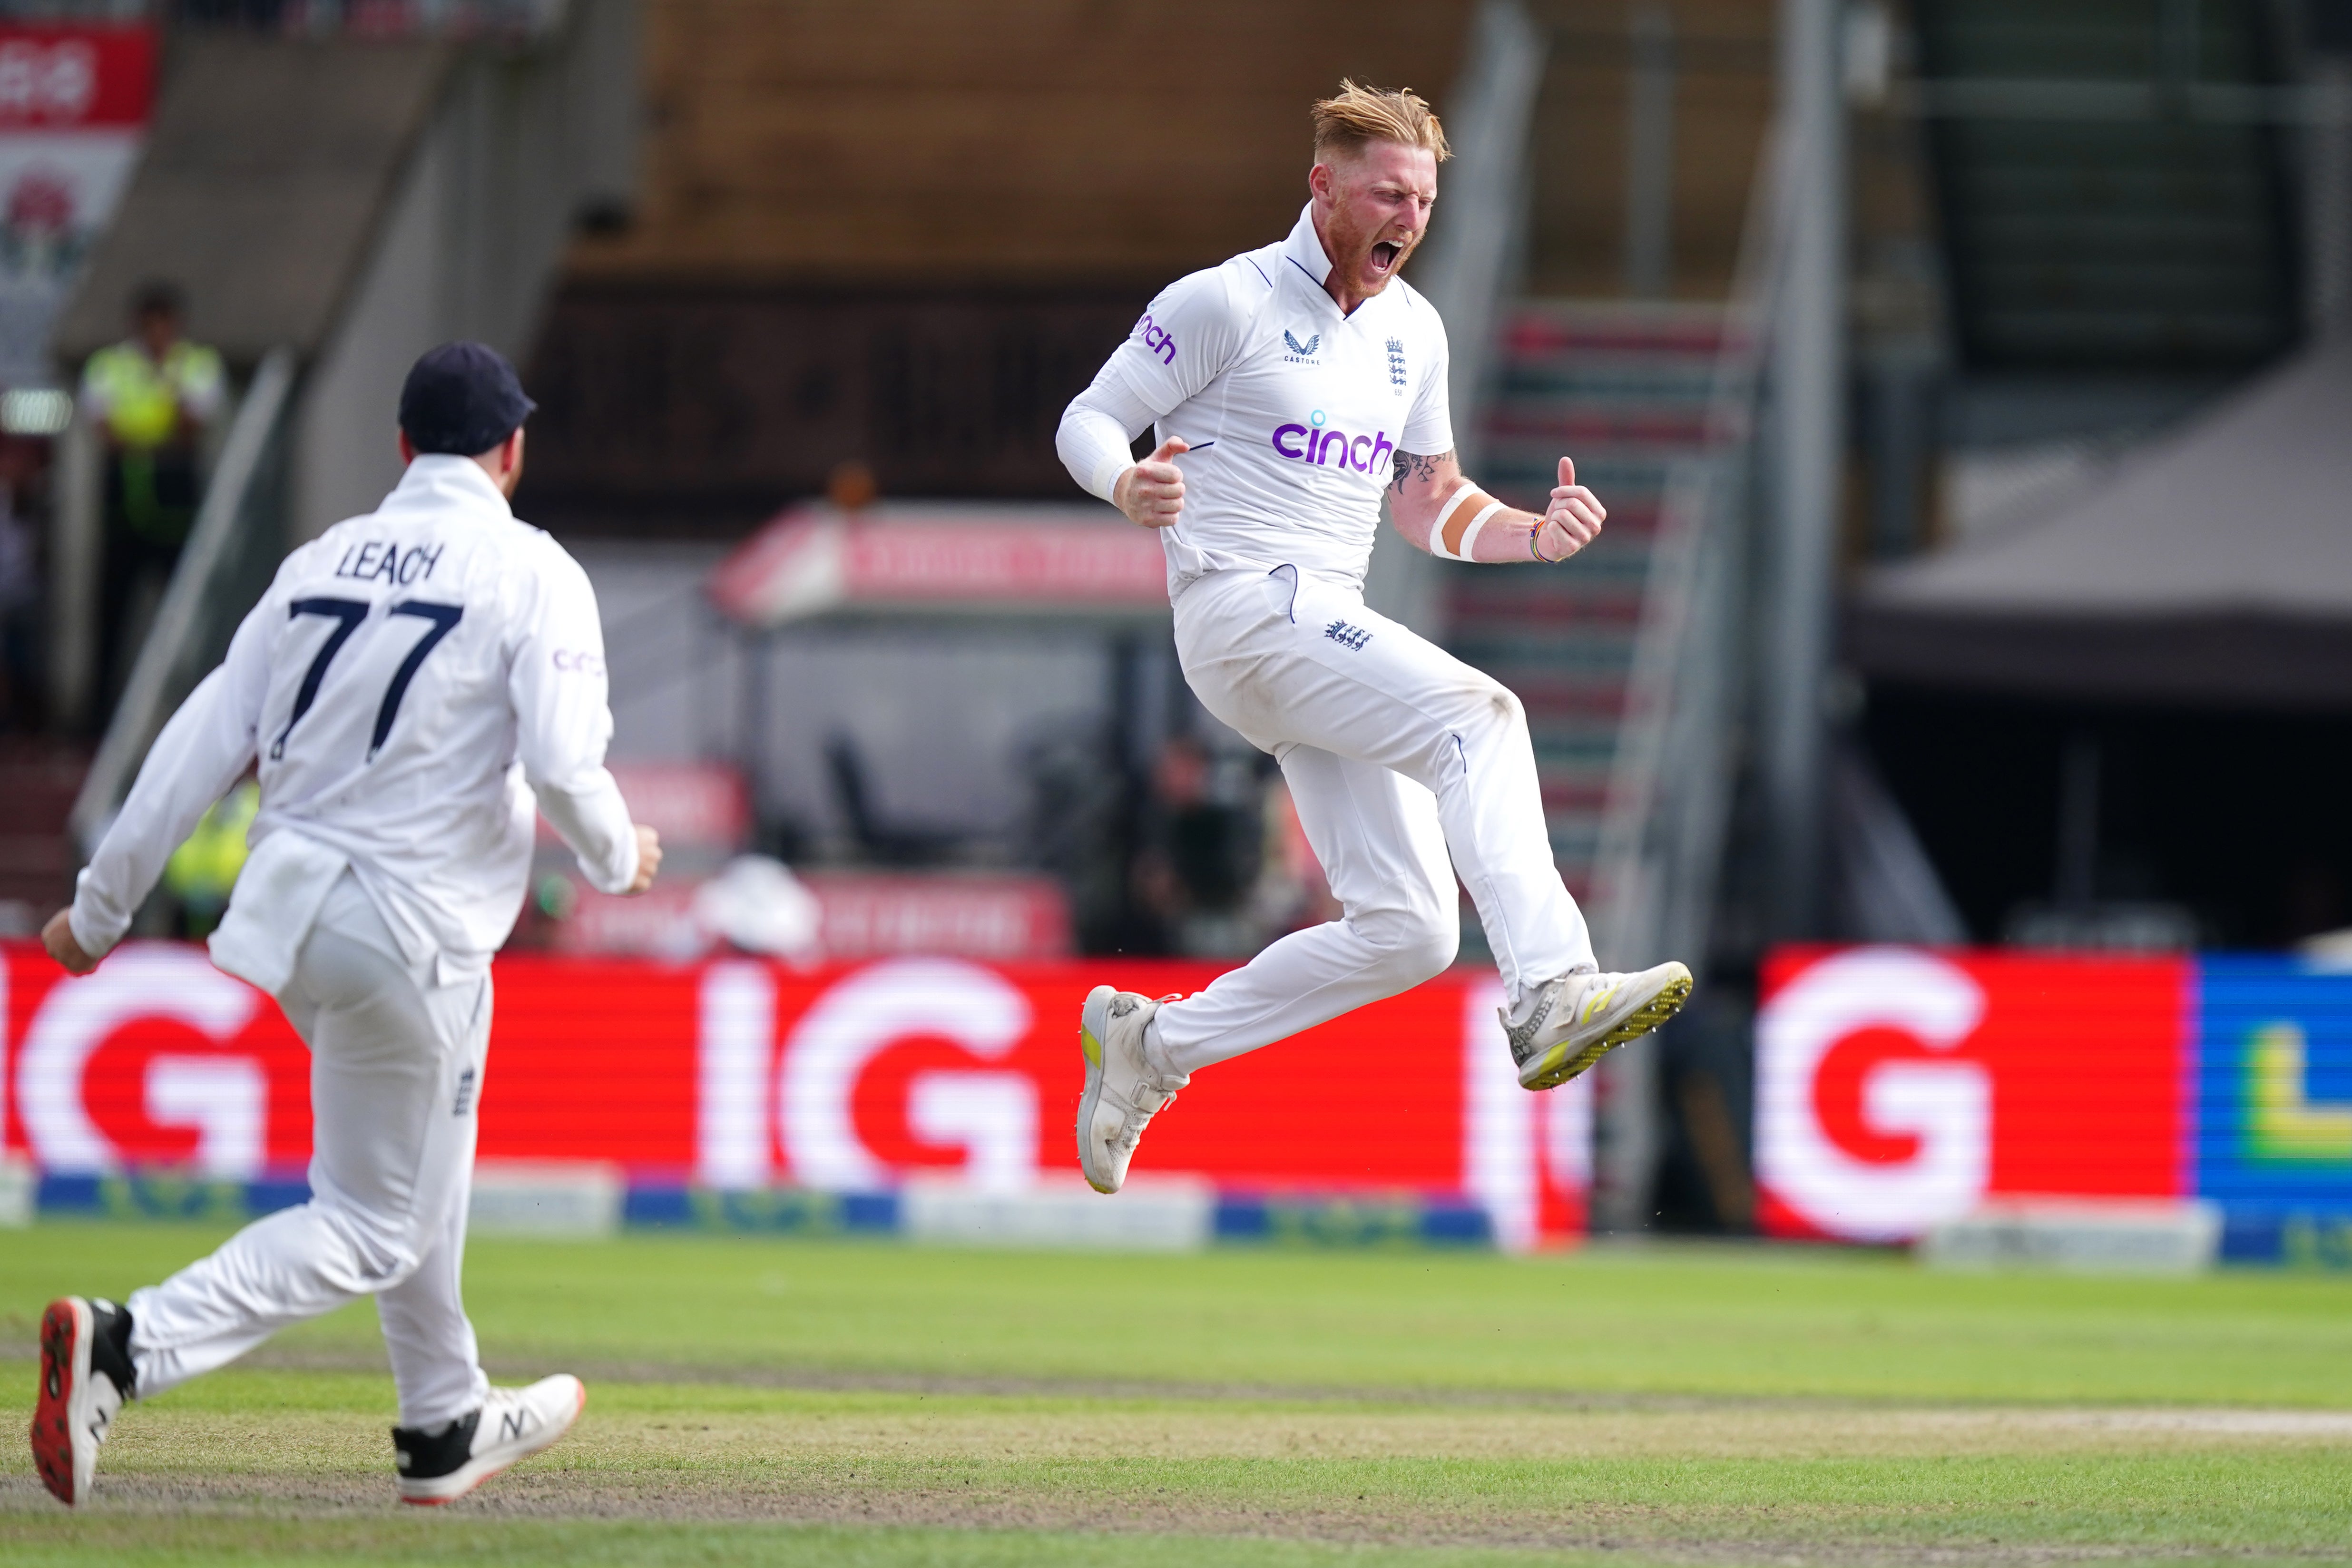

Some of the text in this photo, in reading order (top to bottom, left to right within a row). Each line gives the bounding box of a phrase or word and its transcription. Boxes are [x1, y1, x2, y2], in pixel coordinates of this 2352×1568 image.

[1284, 355, 1320, 365] CASTORE
[1272, 410, 1393, 476] cinch
[335, 542, 444, 585] LEACH
[270, 597, 464, 764] 77
[0, 940, 267, 1182] G
[696, 956, 1040, 1189] IG
